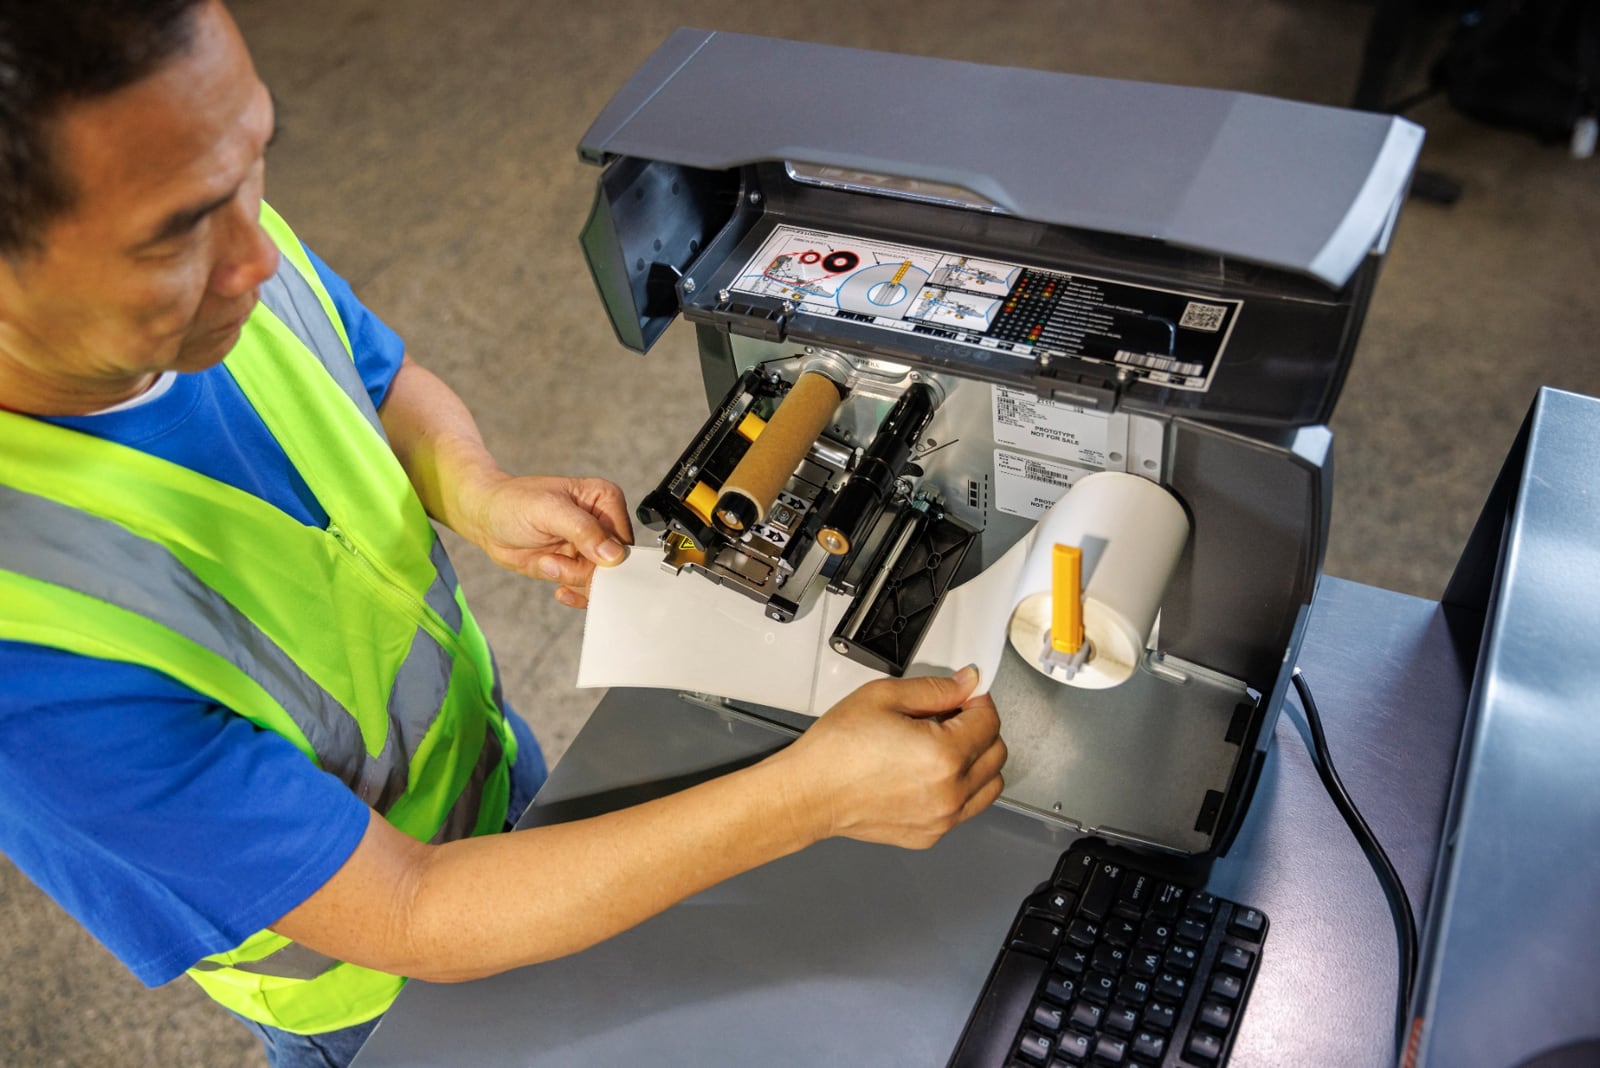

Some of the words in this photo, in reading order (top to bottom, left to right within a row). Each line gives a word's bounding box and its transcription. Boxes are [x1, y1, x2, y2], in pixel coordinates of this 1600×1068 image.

[1030, 430, 1045, 439] NOT
[1062, 436, 1079, 445] SALE
[1034, 425, 1076, 439] PROTOTYPE
